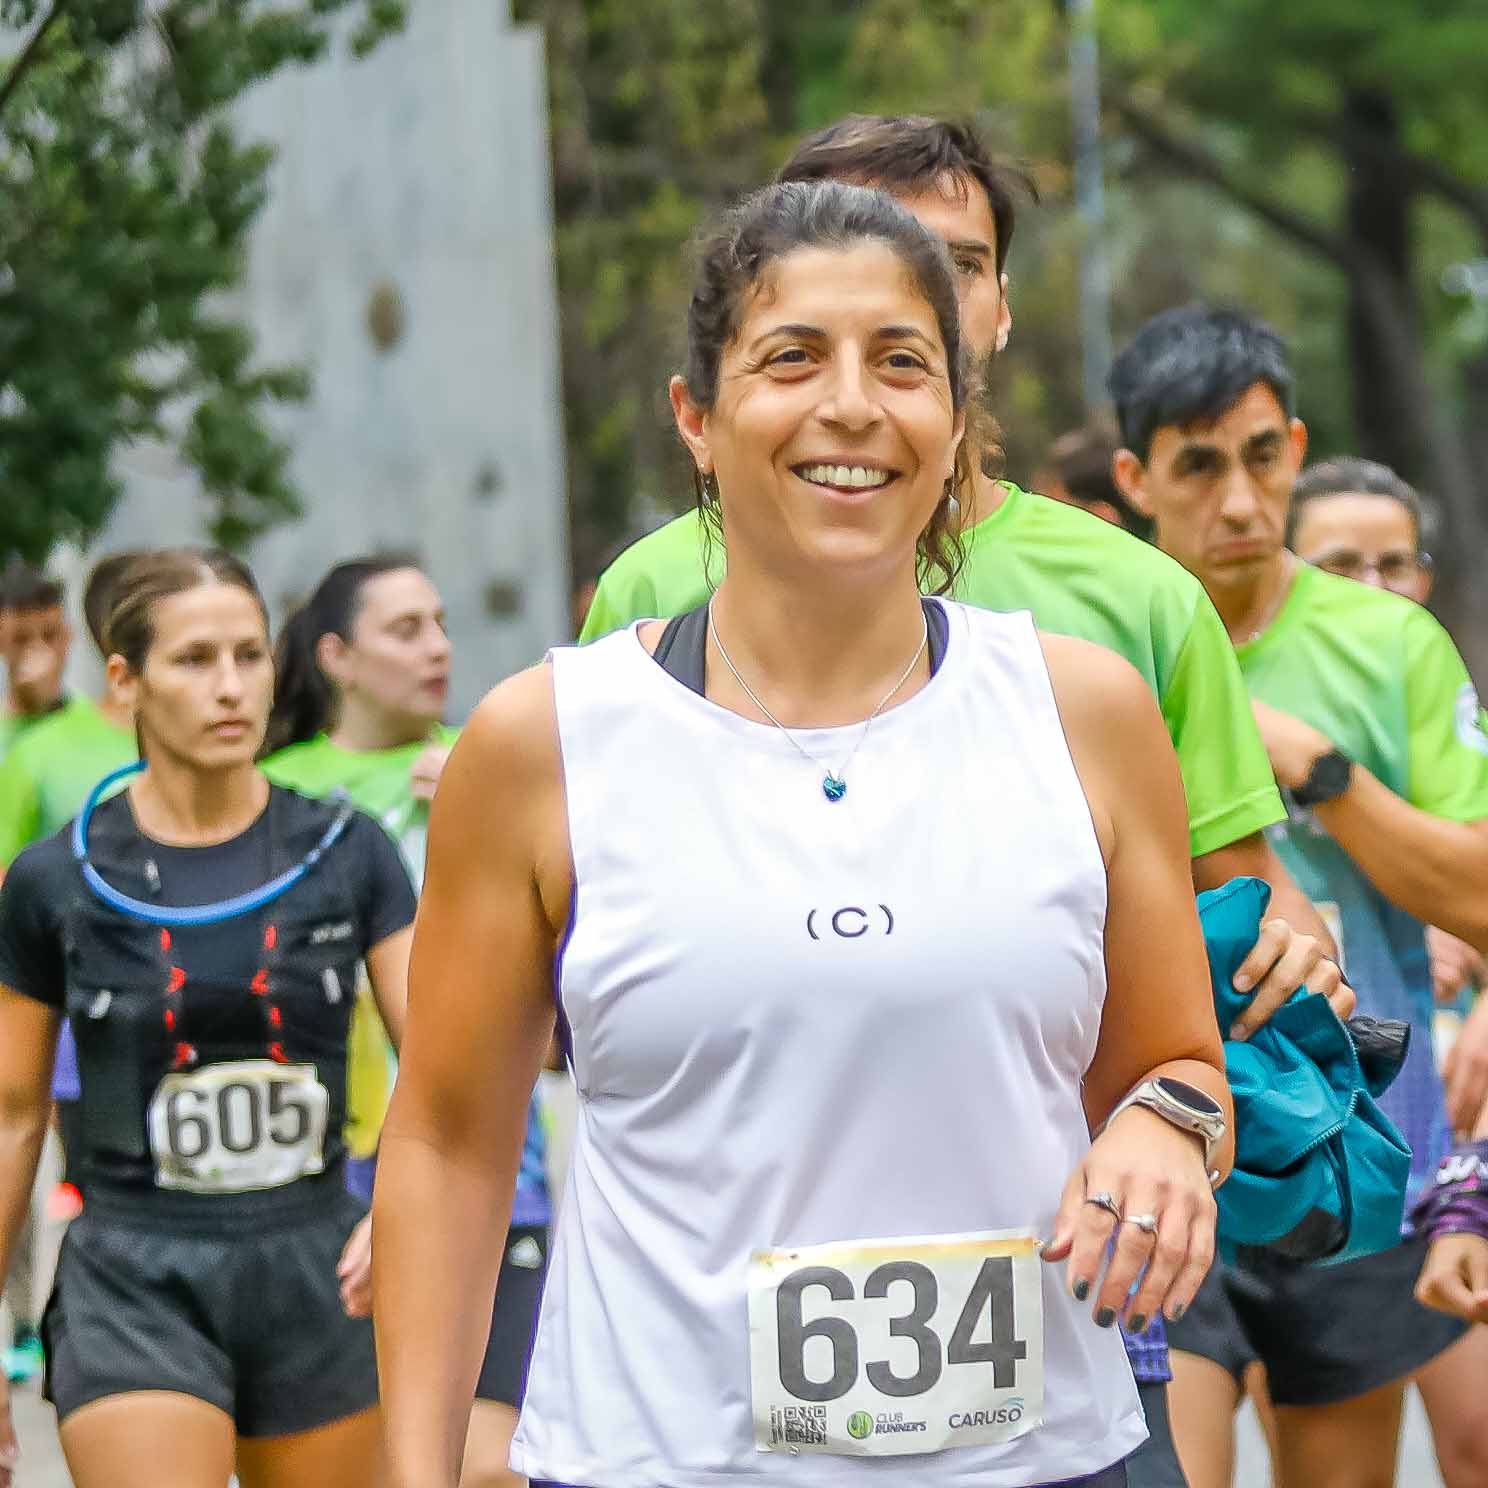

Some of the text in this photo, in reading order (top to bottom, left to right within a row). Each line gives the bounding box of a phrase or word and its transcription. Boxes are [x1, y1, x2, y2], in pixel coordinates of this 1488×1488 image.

[806, 903, 894, 940] (C)
[167, 1080, 310, 1158] 605
[776, 1255, 1027, 1403] 634
[875, 1412, 904, 1424] CLUB
[948, 1406, 1022, 1429] CARUSO
